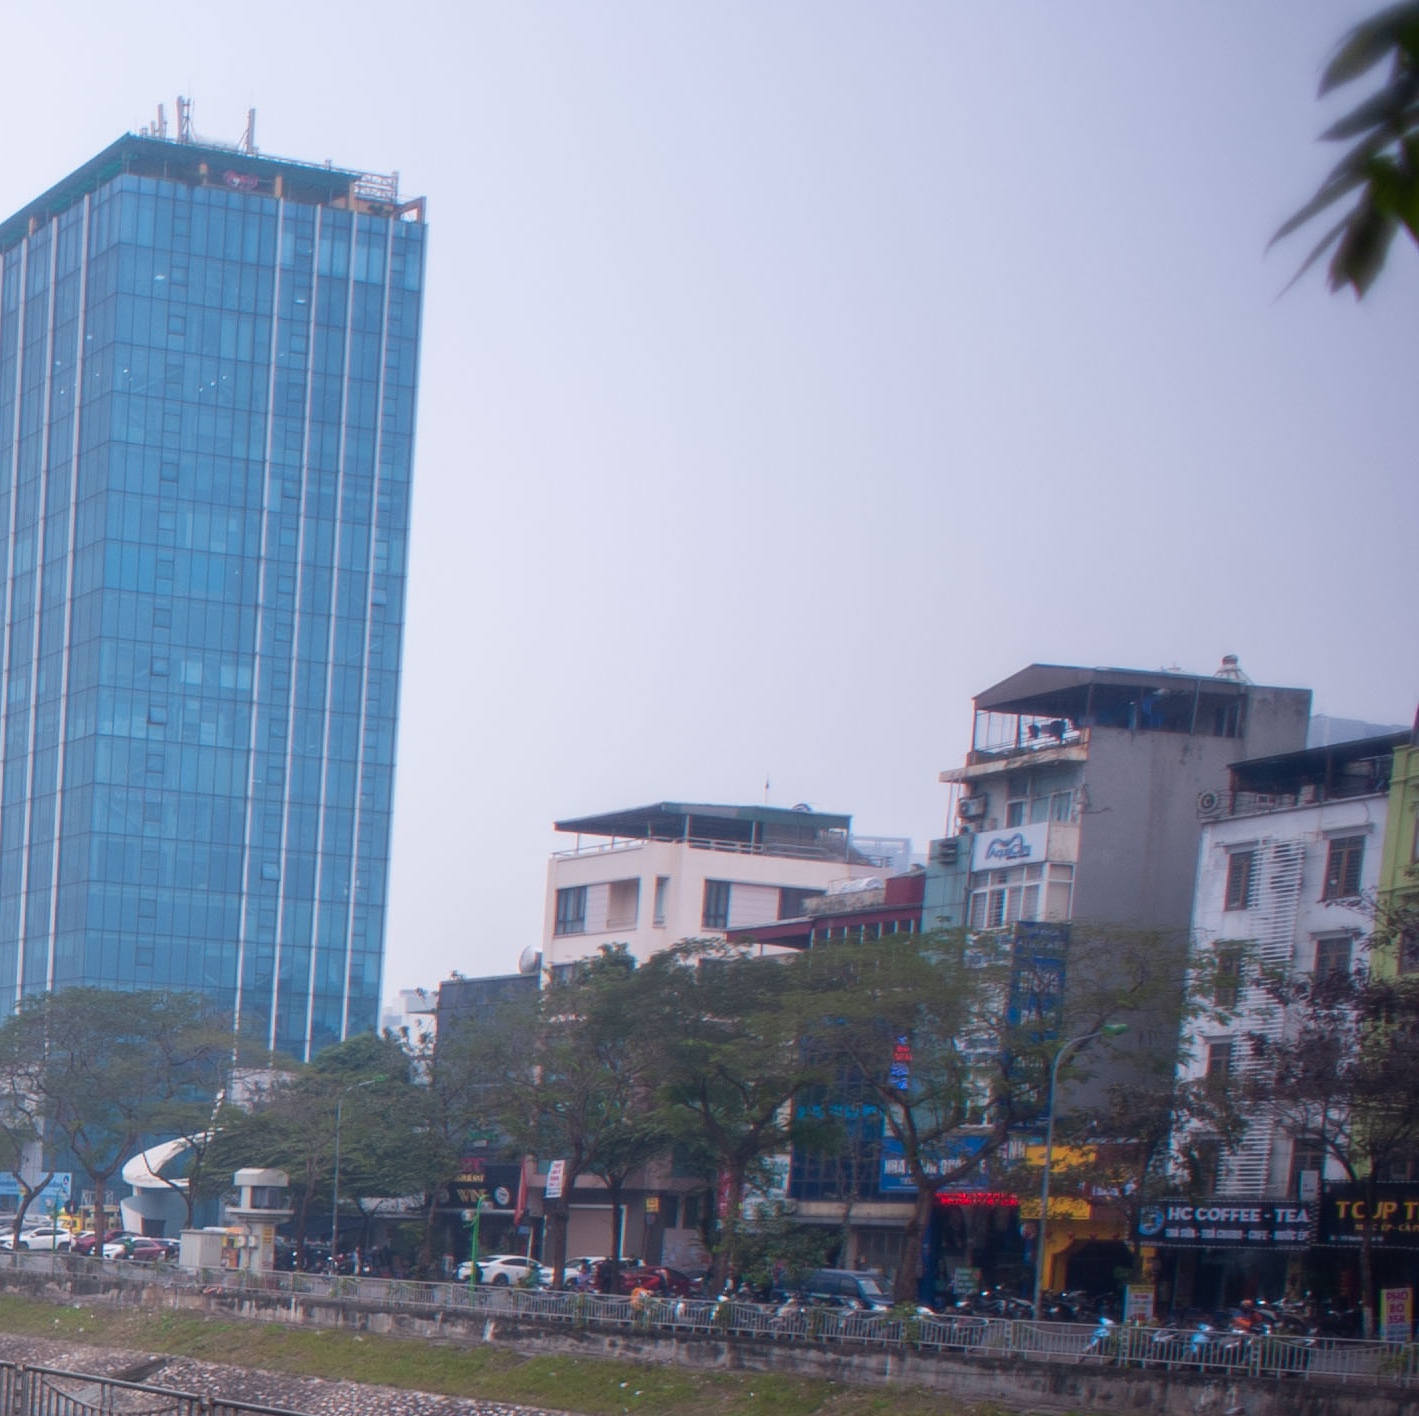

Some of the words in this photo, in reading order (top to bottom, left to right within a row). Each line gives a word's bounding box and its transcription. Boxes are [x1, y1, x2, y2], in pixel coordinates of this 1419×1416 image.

[1168, 1206, 1193, 1221] HC
[1194, 1207, 1262, 1222] COFFEE
[1275, 1208, 1310, 1223] TEA
